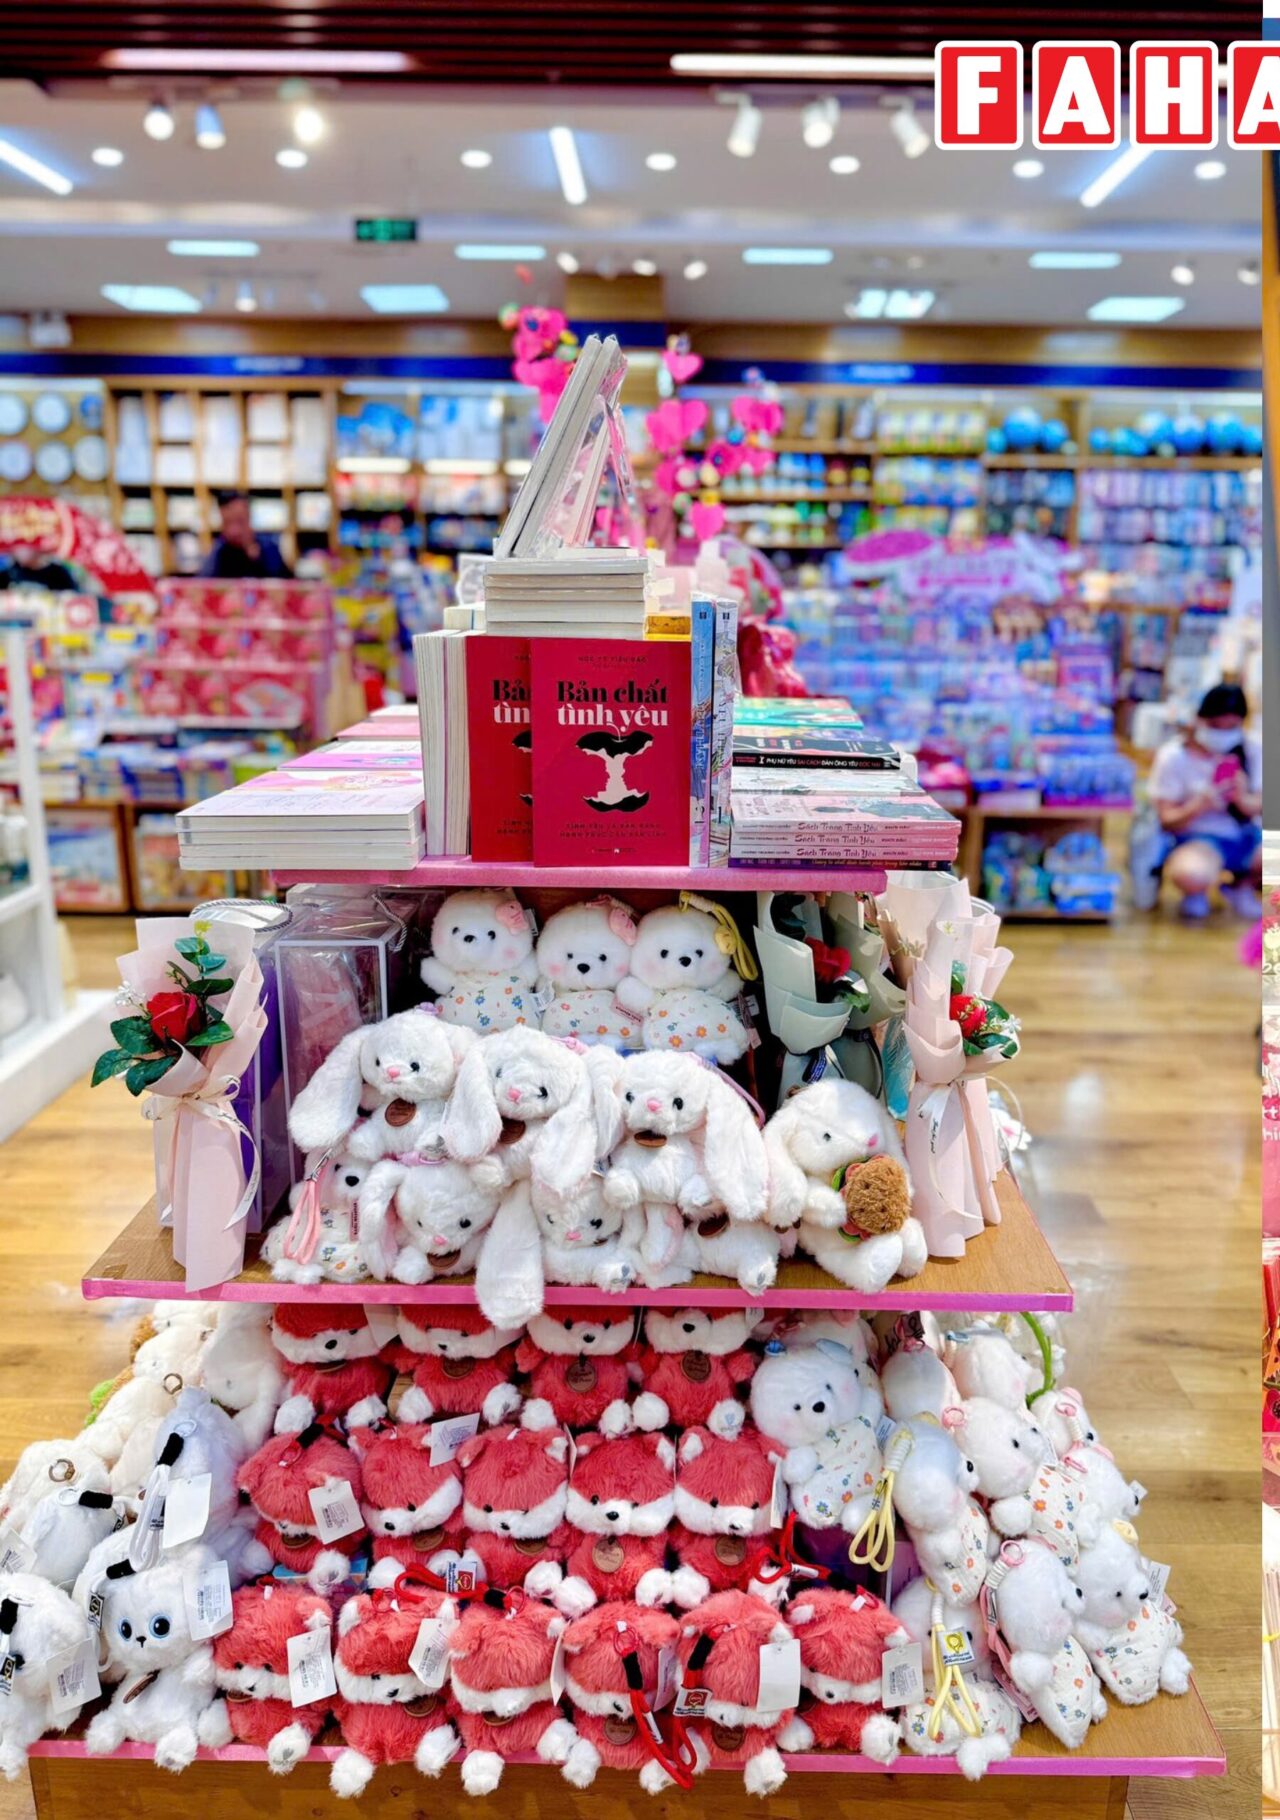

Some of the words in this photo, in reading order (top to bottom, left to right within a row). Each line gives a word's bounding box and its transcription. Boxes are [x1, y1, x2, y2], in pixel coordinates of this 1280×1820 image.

[558, 679, 607, 703] Bản
[613, 678, 668, 704] chất
[558, 702, 614, 726] tình
[619, 704, 669, 733] yêu
